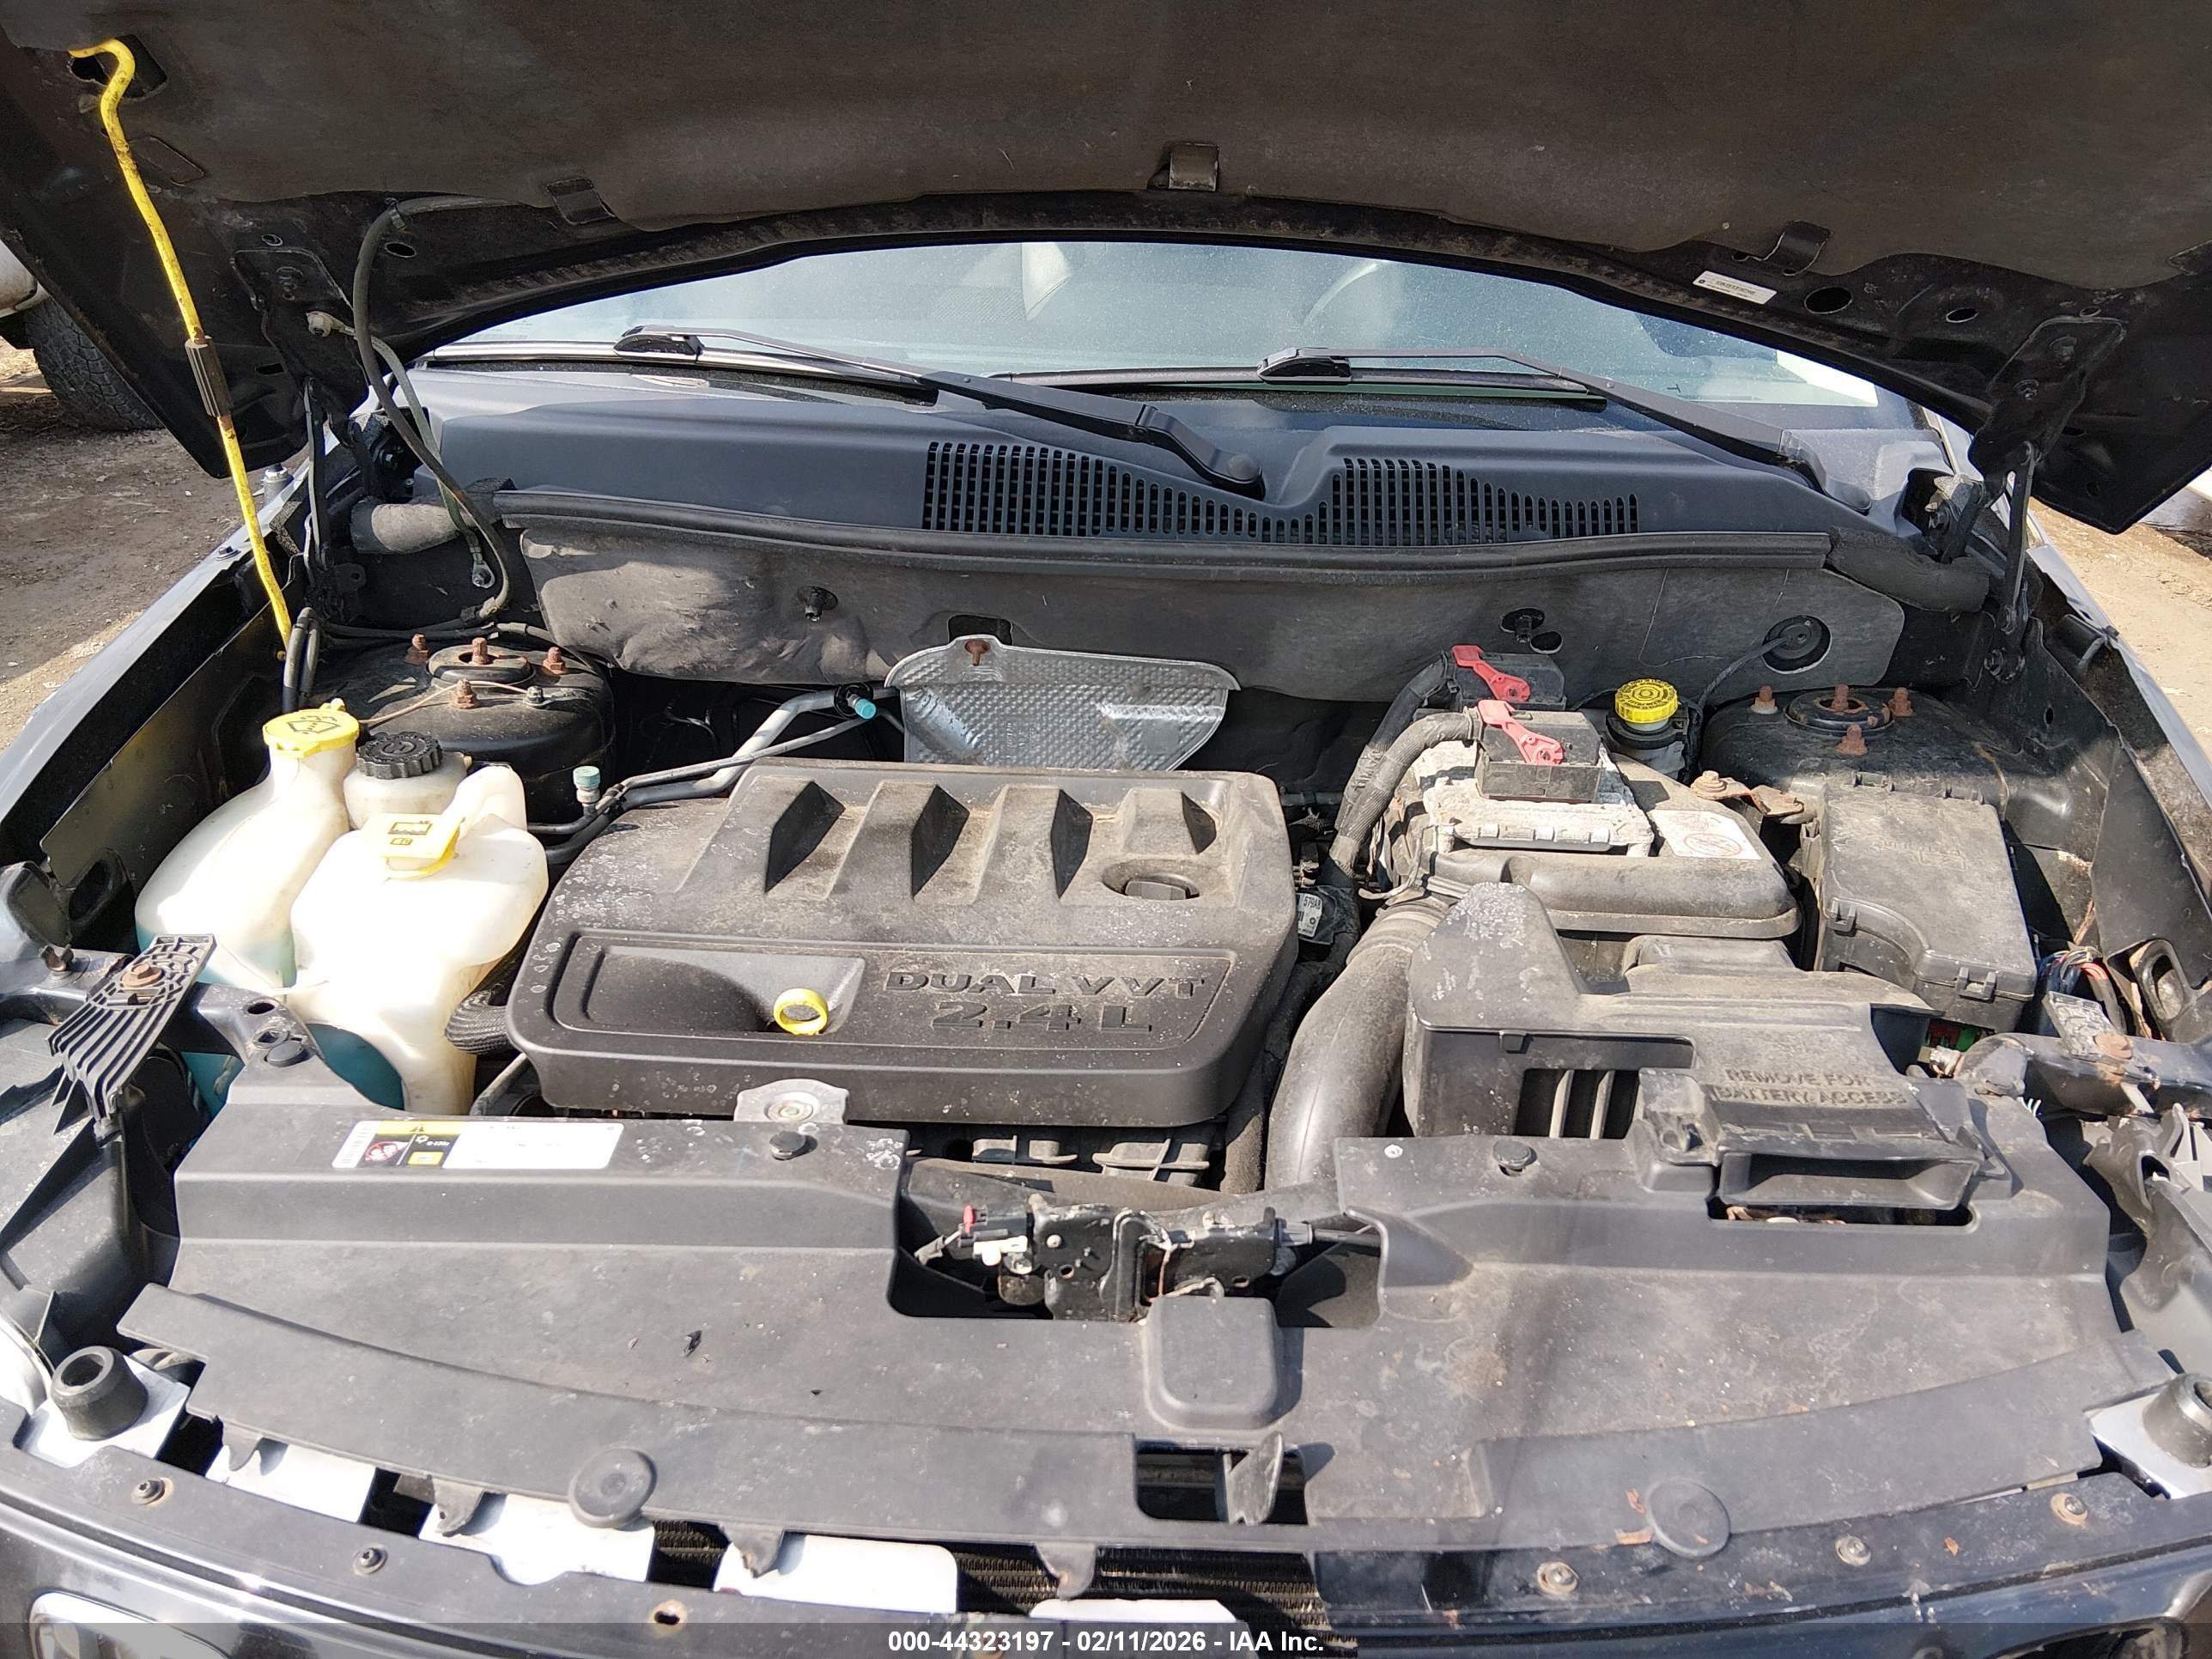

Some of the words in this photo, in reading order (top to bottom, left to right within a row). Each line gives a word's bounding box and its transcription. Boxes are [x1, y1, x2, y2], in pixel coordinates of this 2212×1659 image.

[884, 971, 1056, 995] DUAL
[1072, 975, 1206, 999] VVT
[1723, 1068, 1820, 1086] REMOVE
[1822, 1072, 1871, 1087] FOR
[1716, 1085, 1812, 1104] BATTERY
[1819, 1091, 1908, 1106] ACCESS
